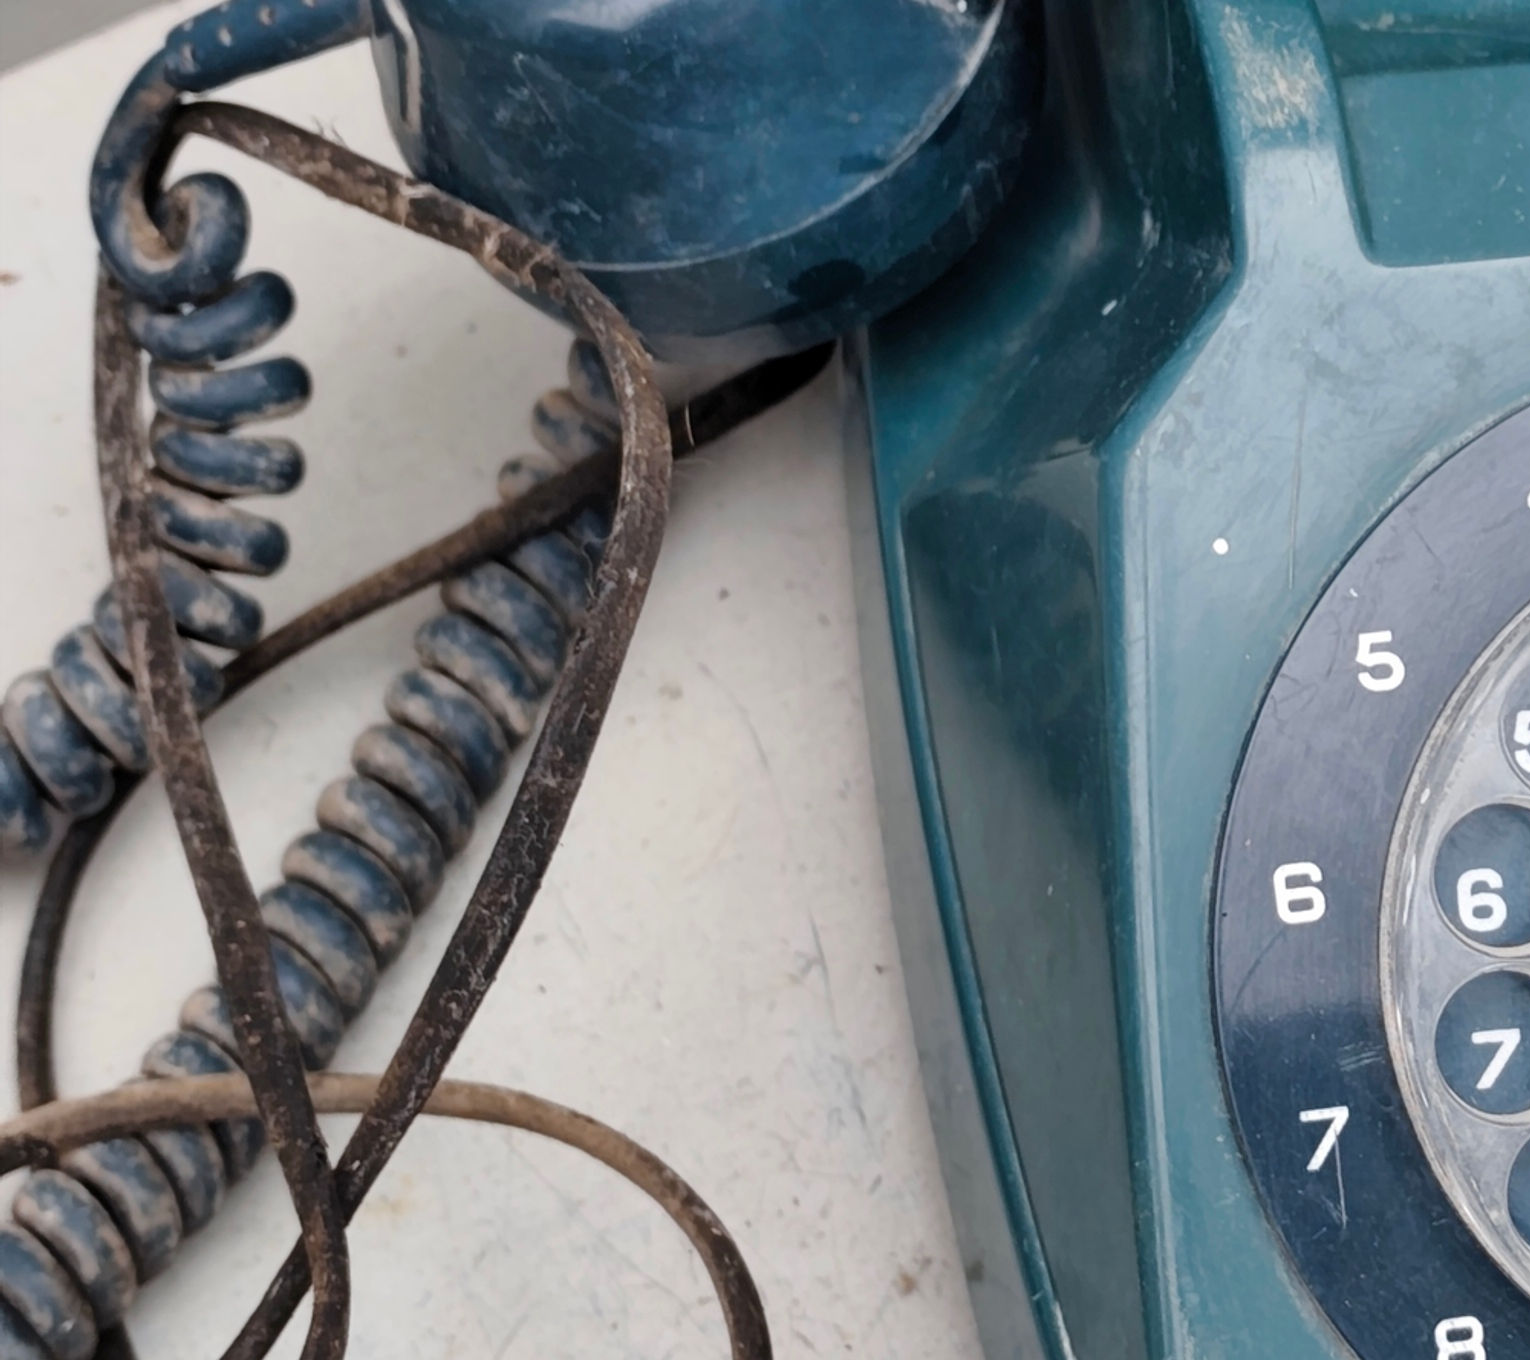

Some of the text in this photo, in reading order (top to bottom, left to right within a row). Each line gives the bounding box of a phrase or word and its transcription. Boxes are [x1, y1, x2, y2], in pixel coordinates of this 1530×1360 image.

[1354, 629, 1406, 692] 5
[1272, 861, 1326, 925] 6
[1456, 867, 1508, 933] 6
[1471, 1028, 1521, 1090] 7
[1299, 1106, 1349, 1171] 7
